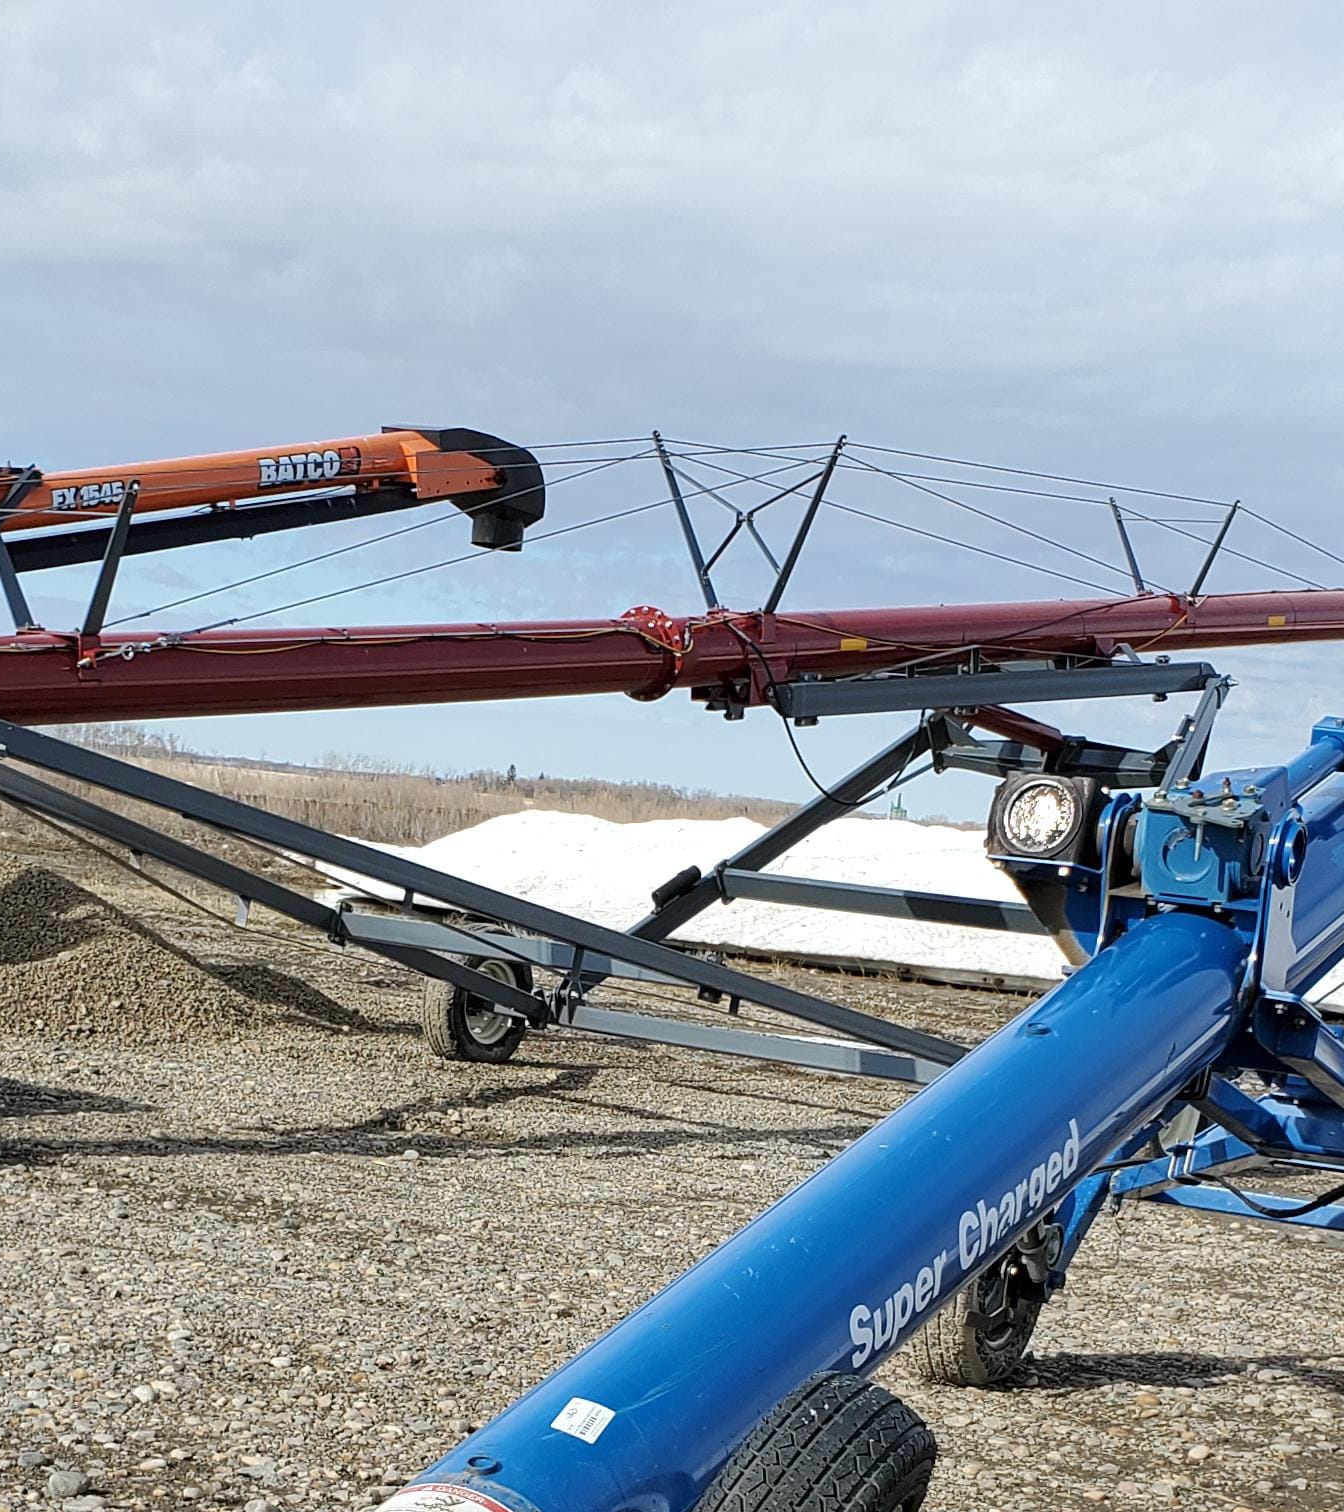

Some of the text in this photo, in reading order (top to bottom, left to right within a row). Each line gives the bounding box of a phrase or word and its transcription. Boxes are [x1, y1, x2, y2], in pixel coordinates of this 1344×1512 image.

[258, 450, 341, 486] BATCO
[52, 481, 124, 509] EX 1545
[849, 1117, 1080, 1369] Super Charged
[436, 1485, 486, 1505] DANGER
